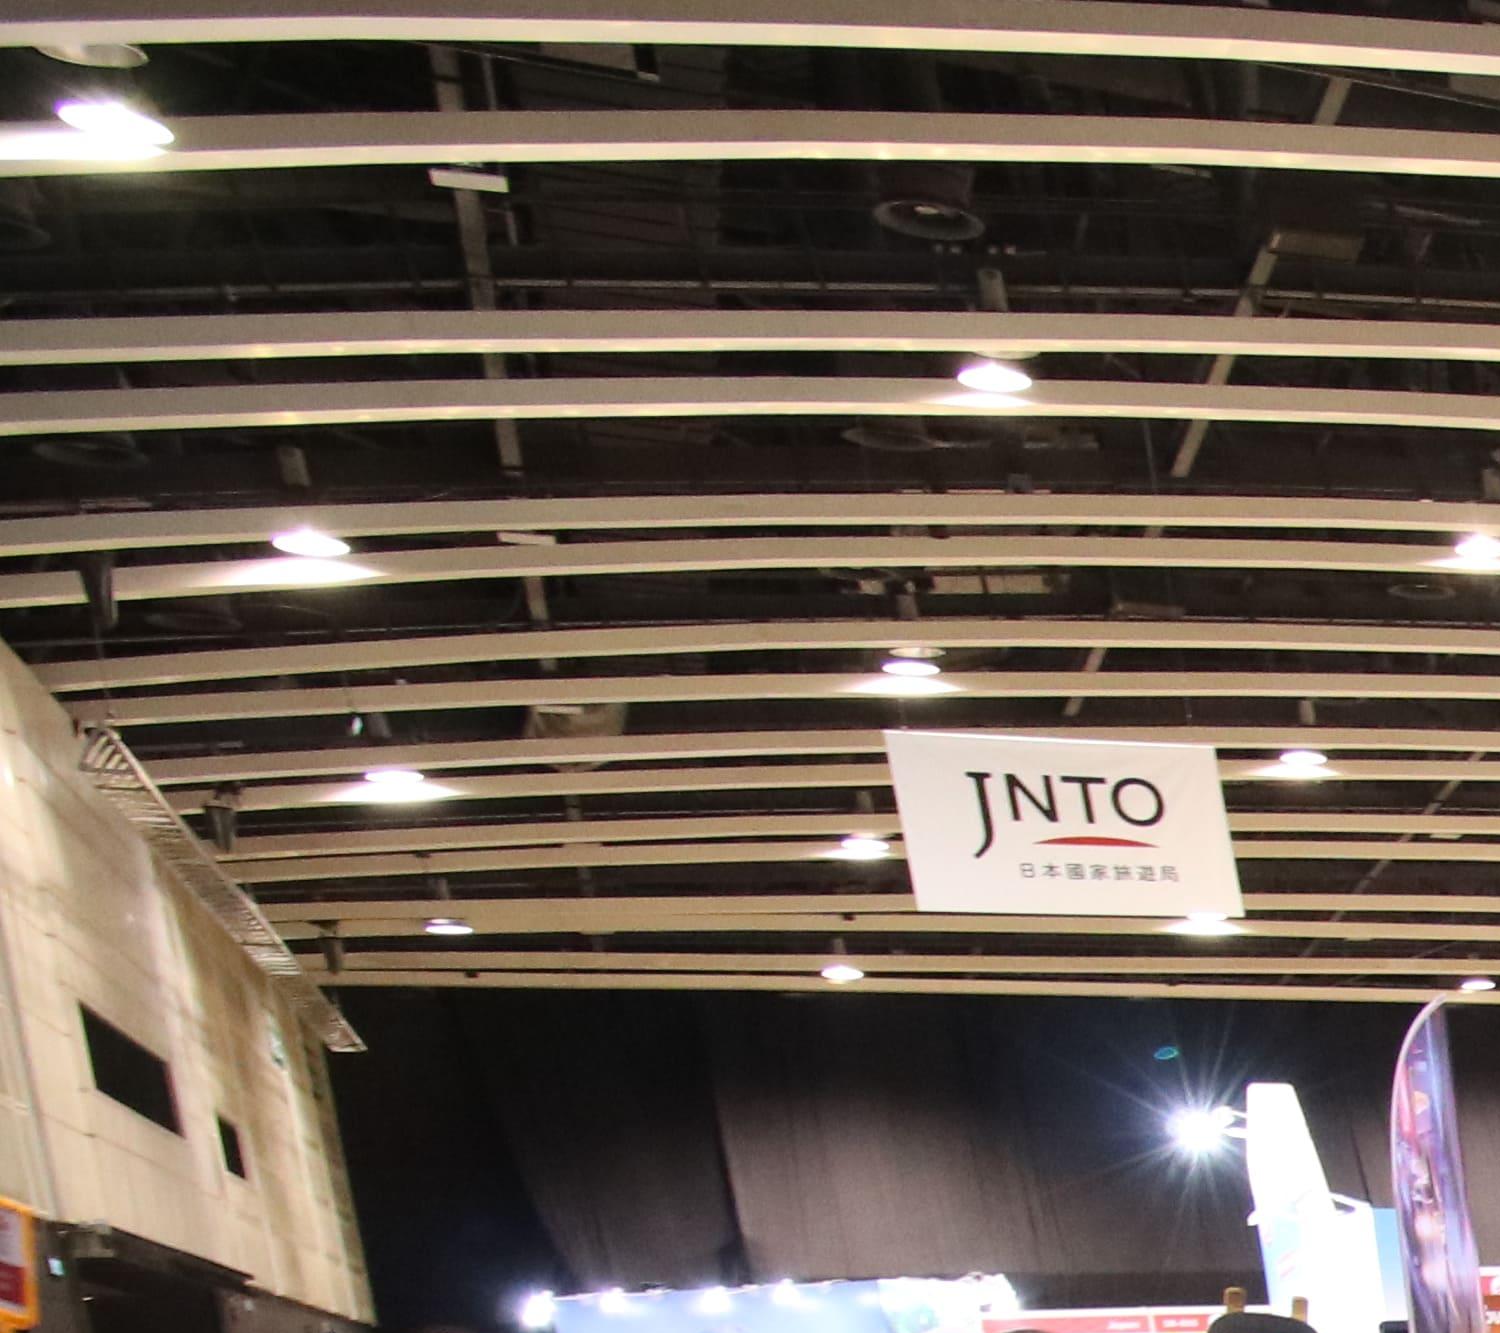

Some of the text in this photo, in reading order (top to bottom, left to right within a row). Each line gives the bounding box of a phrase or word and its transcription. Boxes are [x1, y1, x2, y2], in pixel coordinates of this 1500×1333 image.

[964, 770, 1166, 859] JNTO
[1018, 861, 1181, 883] 日本國家旅遊局
